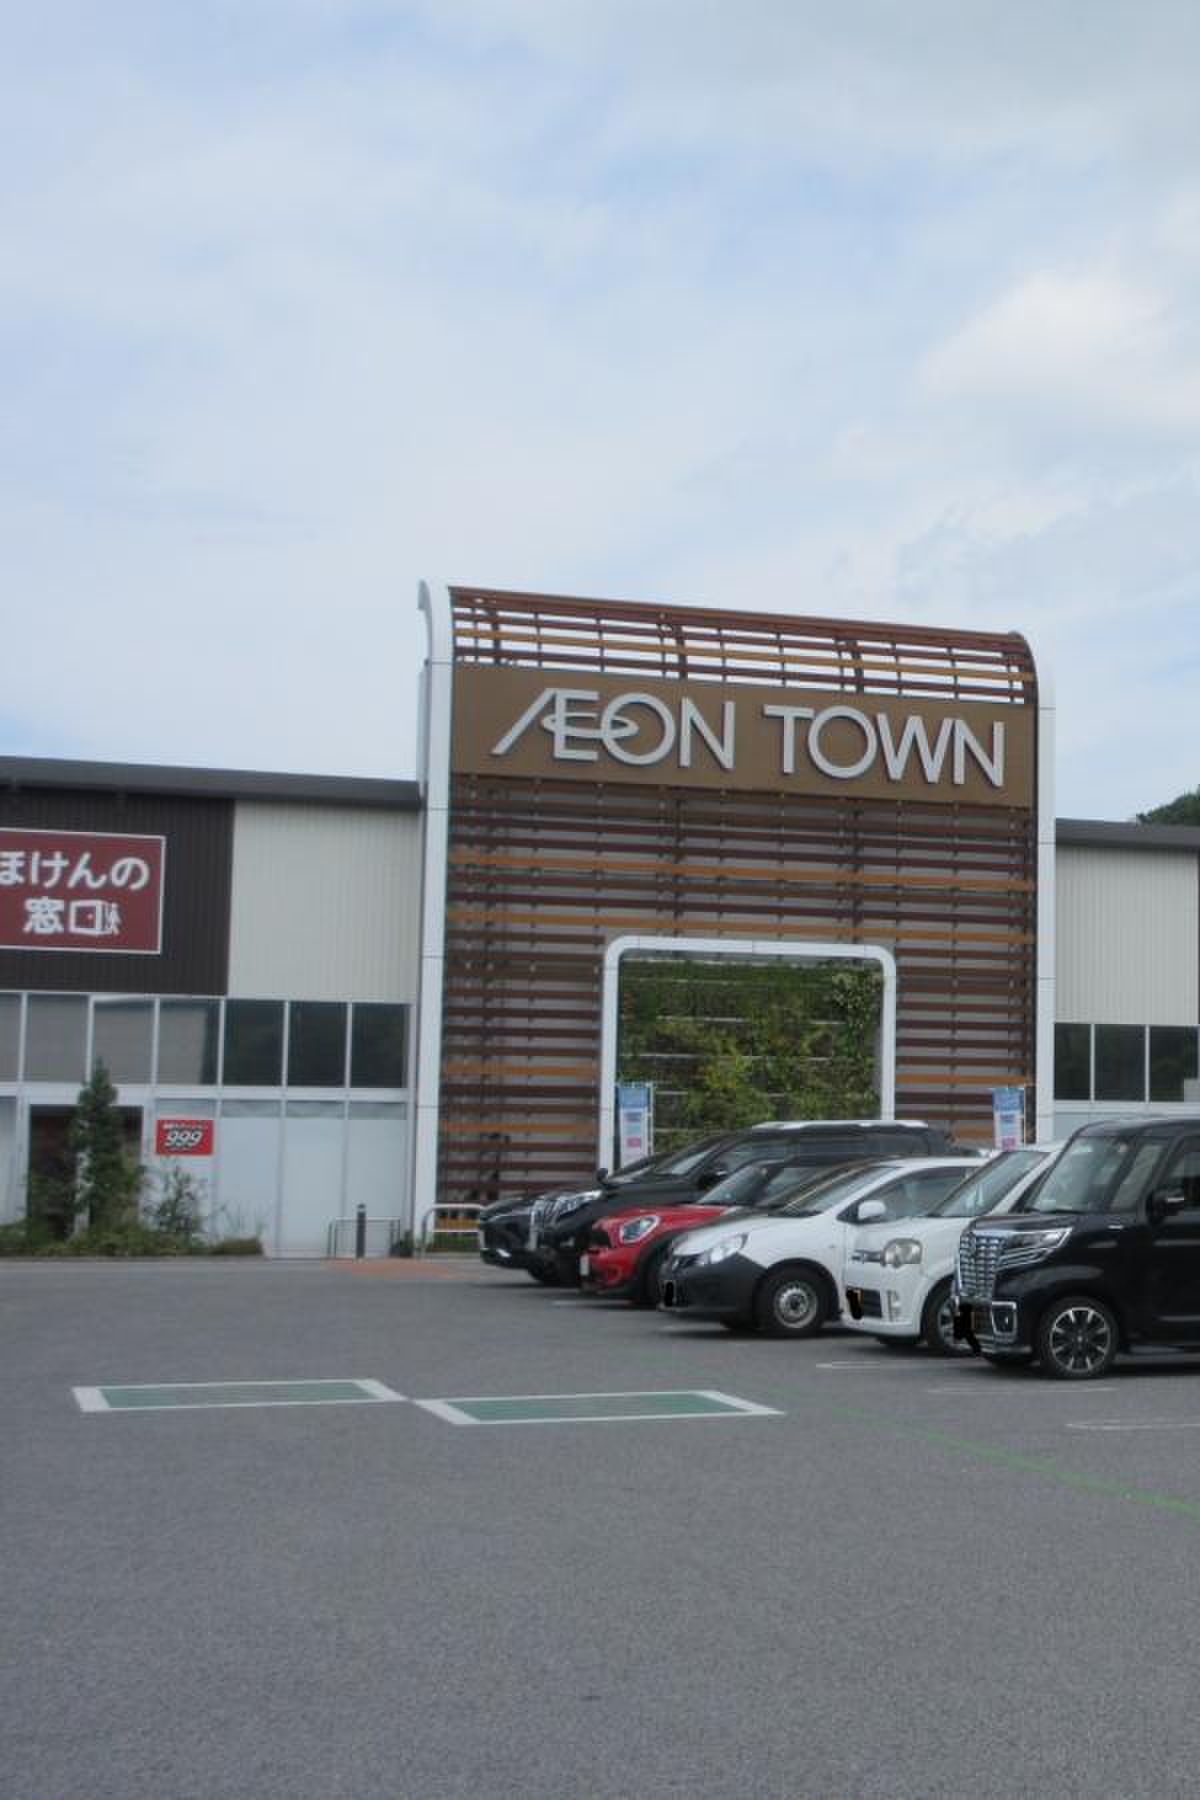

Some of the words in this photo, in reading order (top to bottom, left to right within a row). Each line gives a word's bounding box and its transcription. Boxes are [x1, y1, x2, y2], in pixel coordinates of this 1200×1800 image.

[763, 703, 1004, 788] TOWN
[0, 851, 150, 891] ほけんの
[22, 896, 114, 936] 窓口
[163, 1129, 204, 1148] 999
